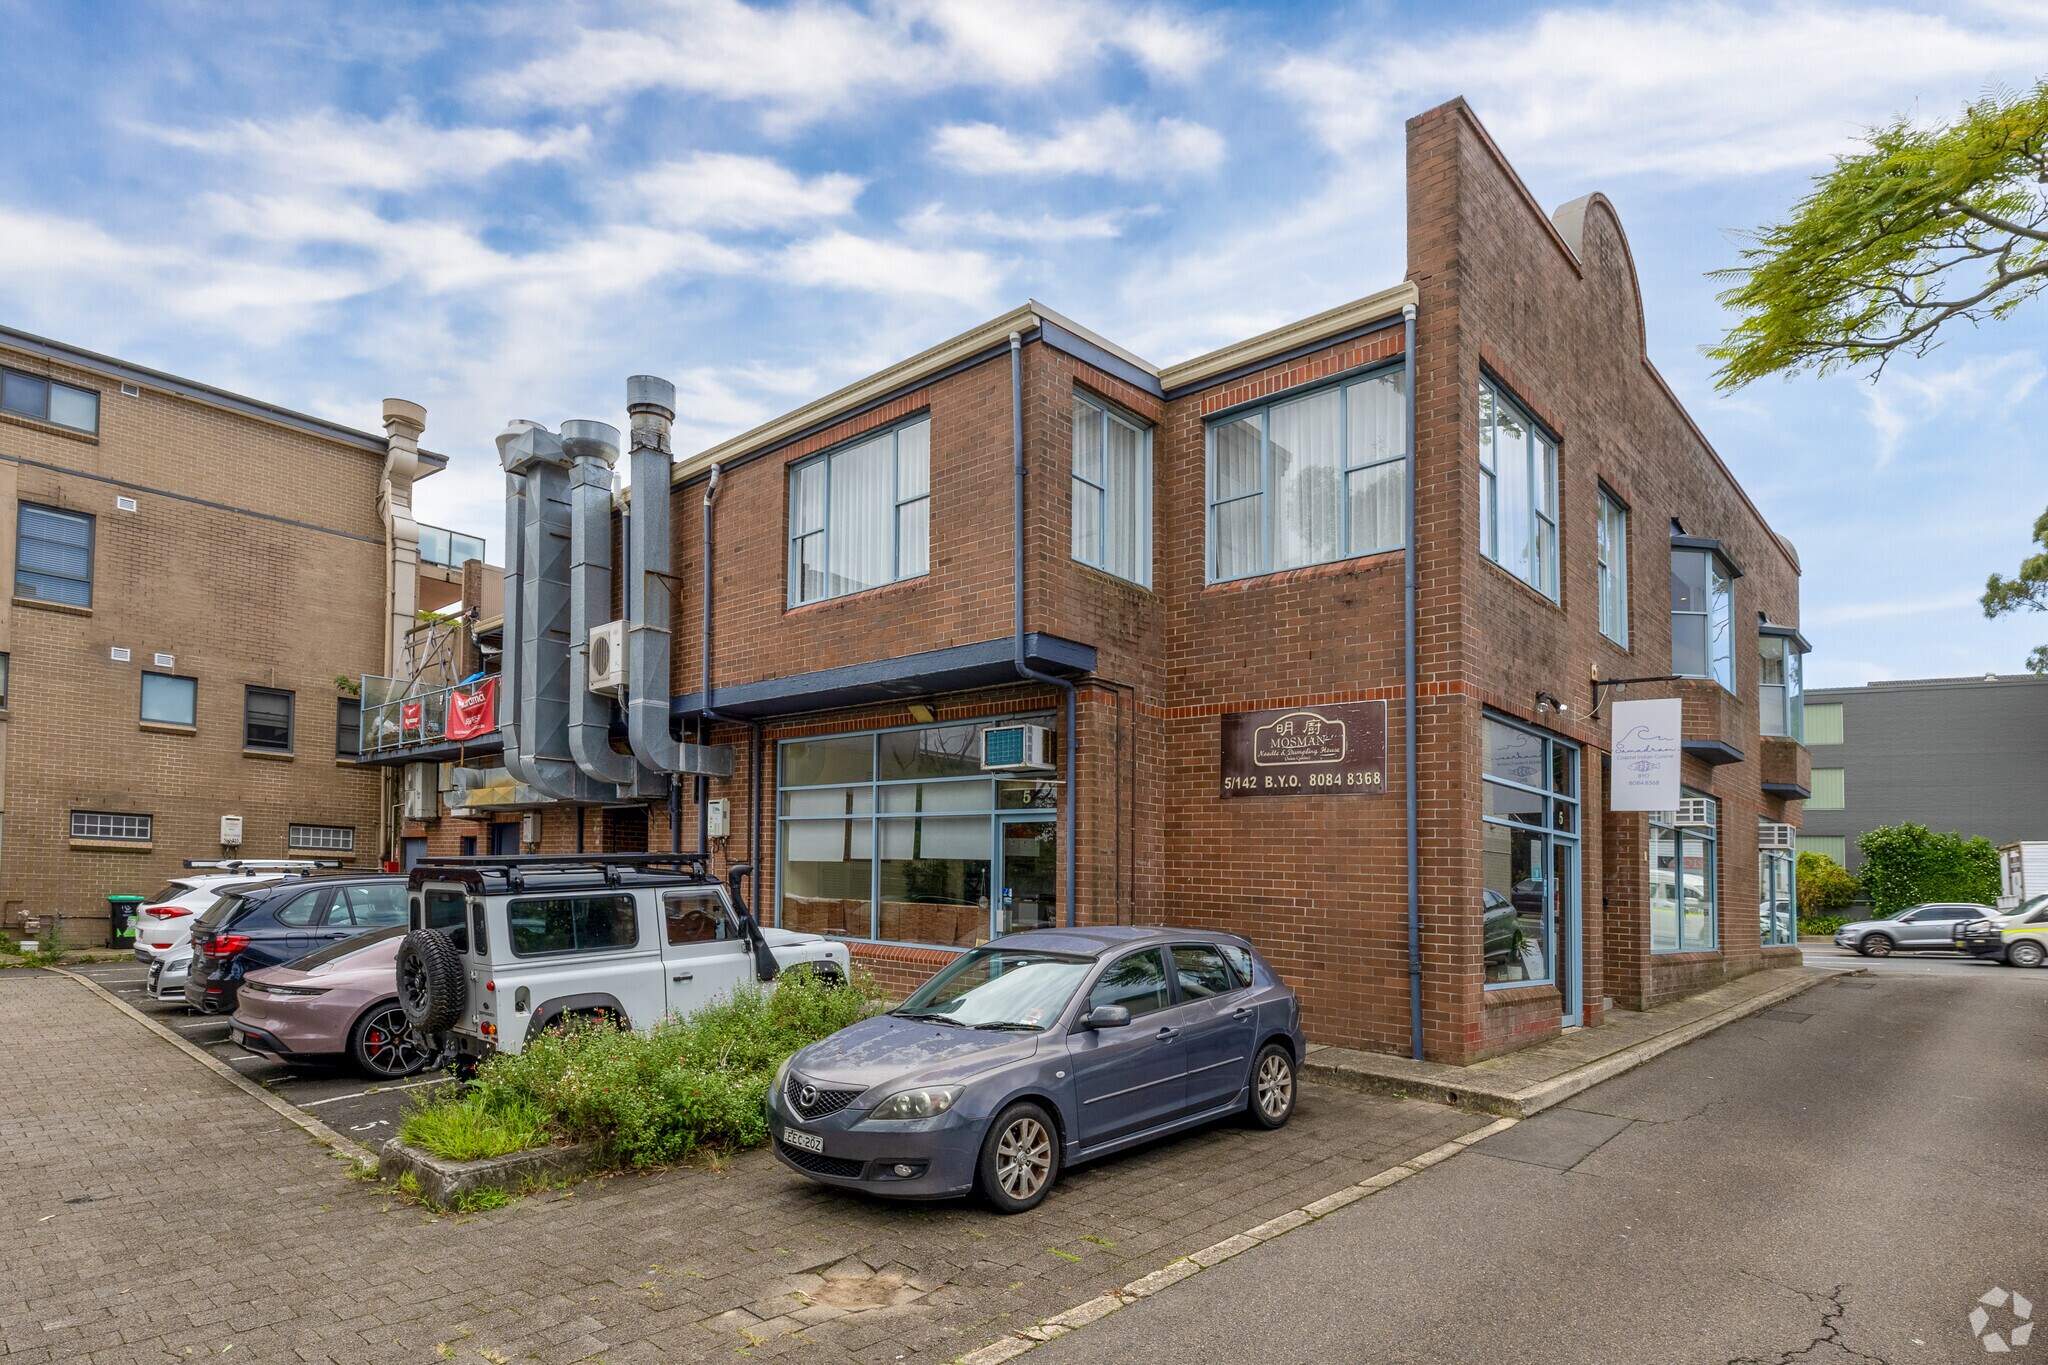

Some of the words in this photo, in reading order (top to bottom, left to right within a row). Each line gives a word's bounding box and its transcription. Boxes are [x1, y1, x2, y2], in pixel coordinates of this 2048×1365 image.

[1270, 736, 1325, 749] MOSMAN
[1285, 747, 1318, 757] Dumpling
[1224, 776, 1257, 789] 5/142
[1265, 775, 1302, 788] B.Y.O.
[1309, 773, 1342, 786] 8084
[1347, 771, 1381, 785] 8368
[1023, 790, 1031, 804] 5
[1558, 811, 1564, 825] 5
